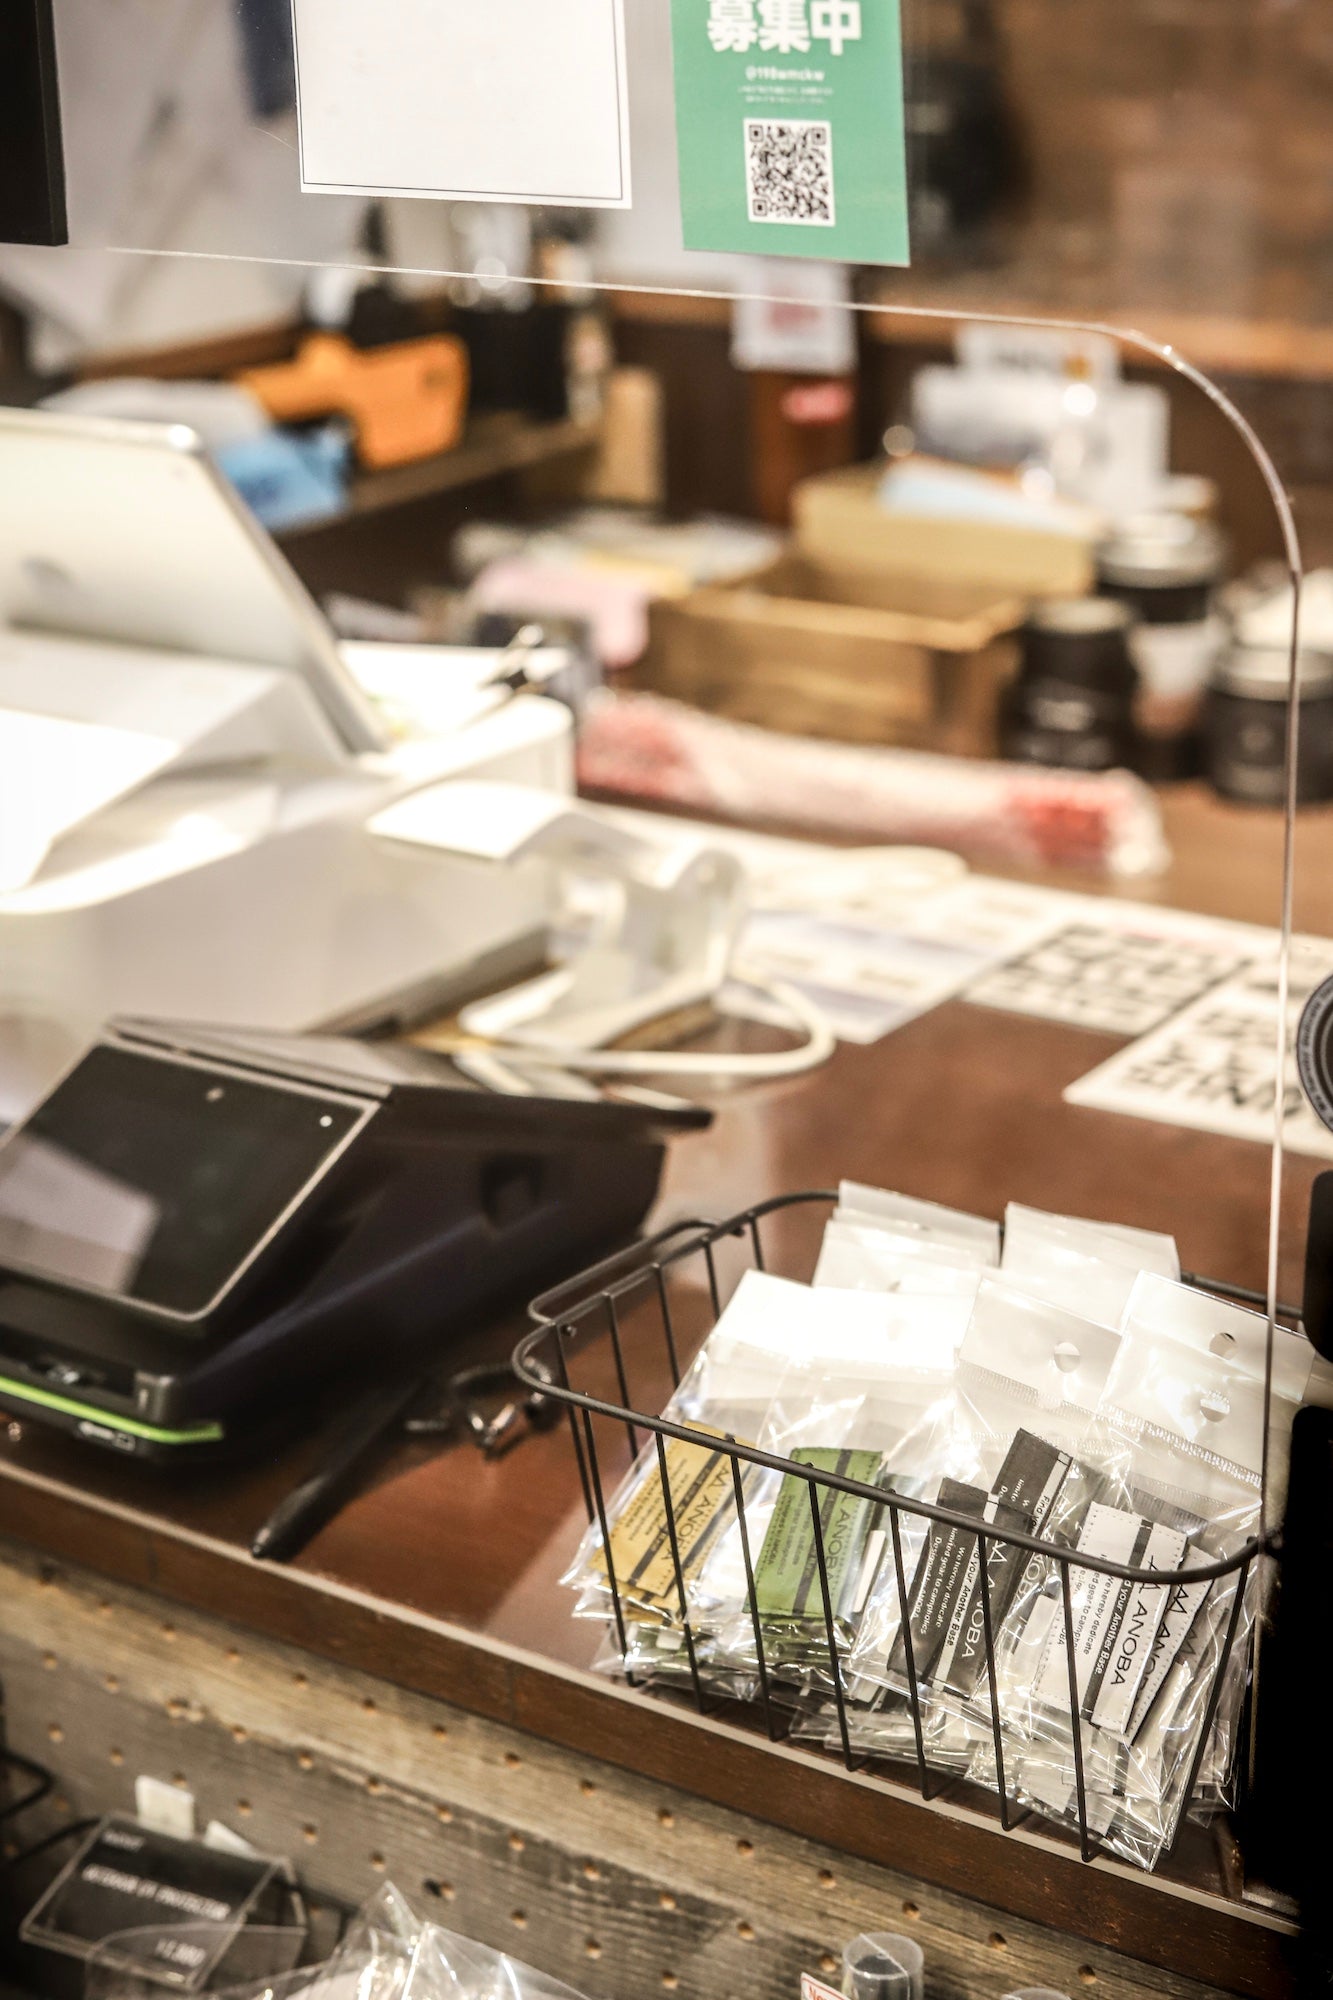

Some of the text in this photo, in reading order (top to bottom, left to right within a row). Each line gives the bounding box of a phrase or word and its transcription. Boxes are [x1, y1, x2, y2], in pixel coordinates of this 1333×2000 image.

[706, 0, 862, 56] 募集中
[1010, 1480, 1025, 1503] limite
[1035, 1495, 1051, 1515] Find
[943, 1527, 958, 1557] limited
[936, 1557, 949, 1577] gear
[965, 1561, 977, 1582] your
[935, 1546, 966, 1628] We hereby dedicate
[1084, 1584, 1097, 1604] gear
[1115, 1588, 1128, 1611] your
[919, 1587, 940, 1635] campholics
[954, 1585, 971, 1622] Another
[1082, 1605, 1091, 1614] to
[1094, 1588, 1110, 1618] hereby
[946, 1623, 960, 1648] Base.
[1083, 1619, 1100, 1655] dedicate
[1103, 1612, 1122, 1651] Another
[1111, 1601, 1148, 1686] ANOBA
[1094, 1650, 1110, 1677] Base.
